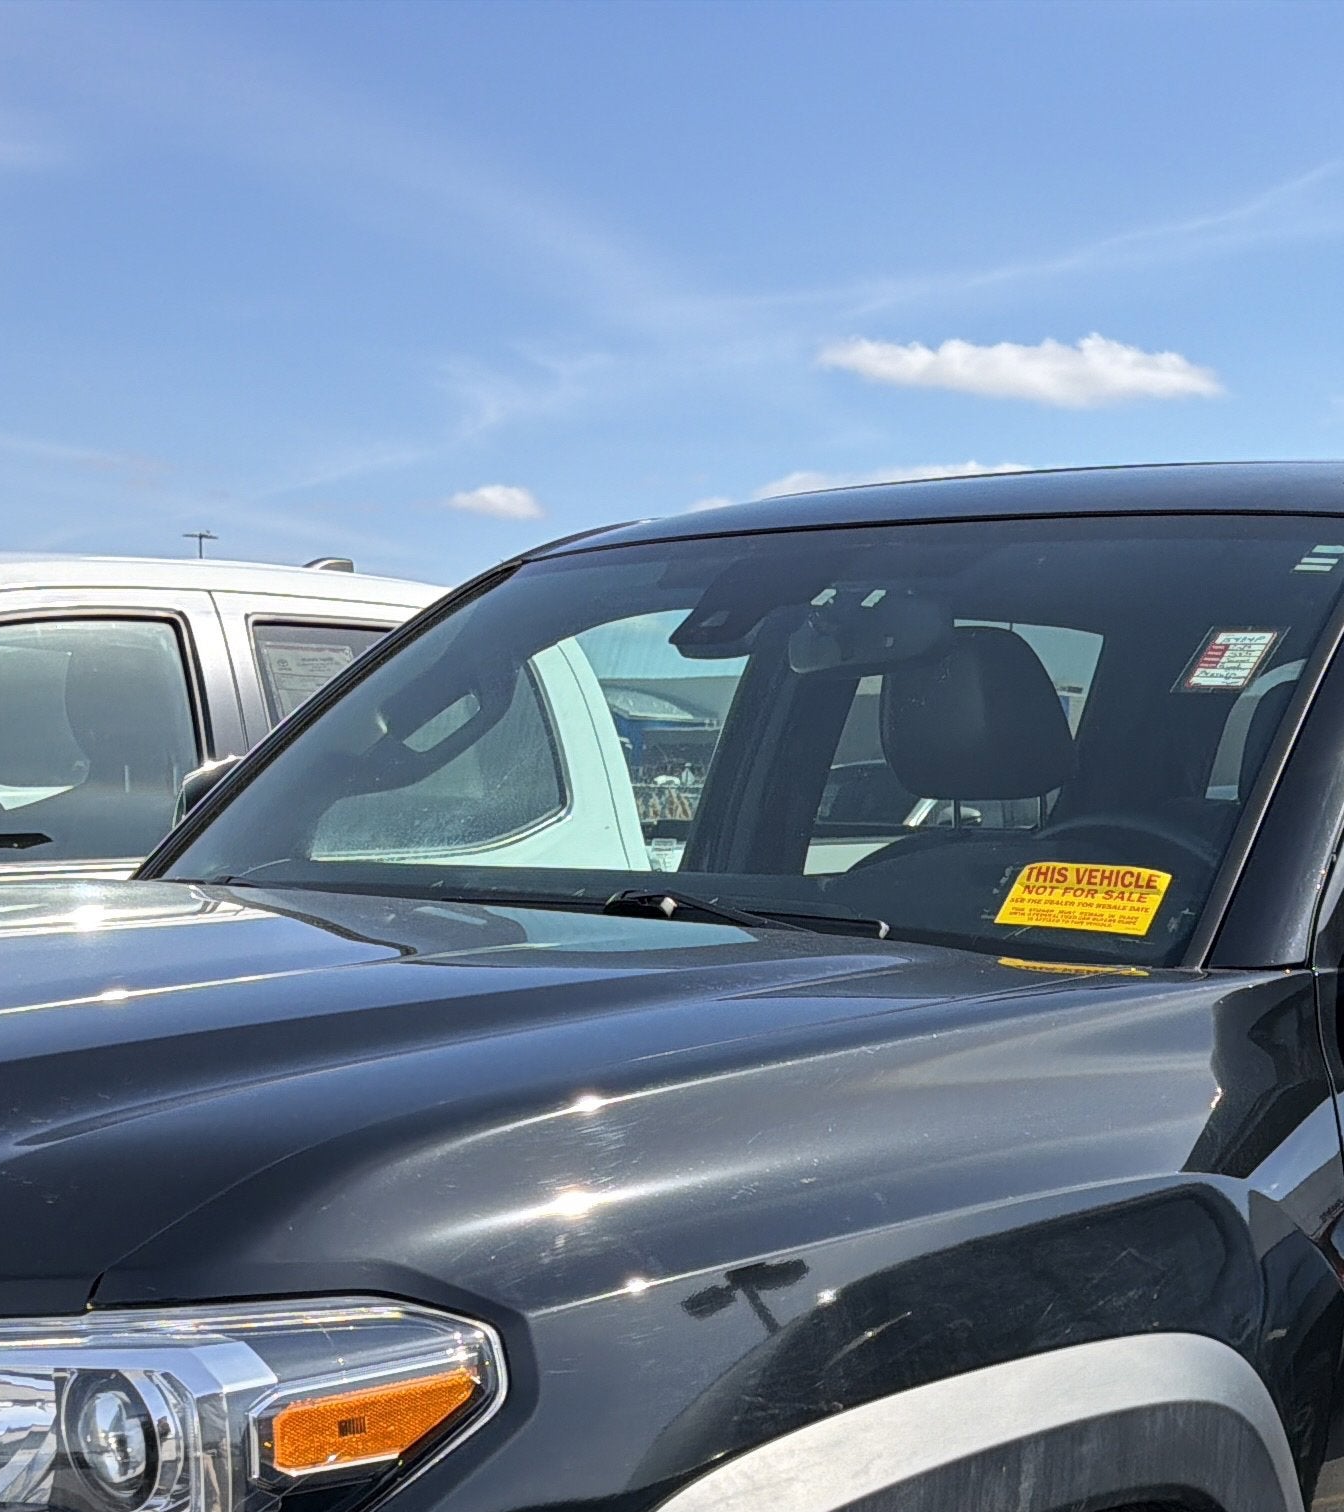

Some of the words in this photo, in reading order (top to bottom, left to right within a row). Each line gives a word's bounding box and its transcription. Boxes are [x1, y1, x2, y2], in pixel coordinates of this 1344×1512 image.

[1026, 865, 1069, 884] THIS
[1075, 867, 1161, 890] VEHICLE
[1022, 884, 1060, 897] NOT
[1061, 886, 1098, 899] FOR
[1102, 889, 1150, 903] SALE
[1044, 899, 1076, 907] DEALER
[1095, 903, 1129, 911] RESALE
[1129, 905, 1151, 913] DATE
